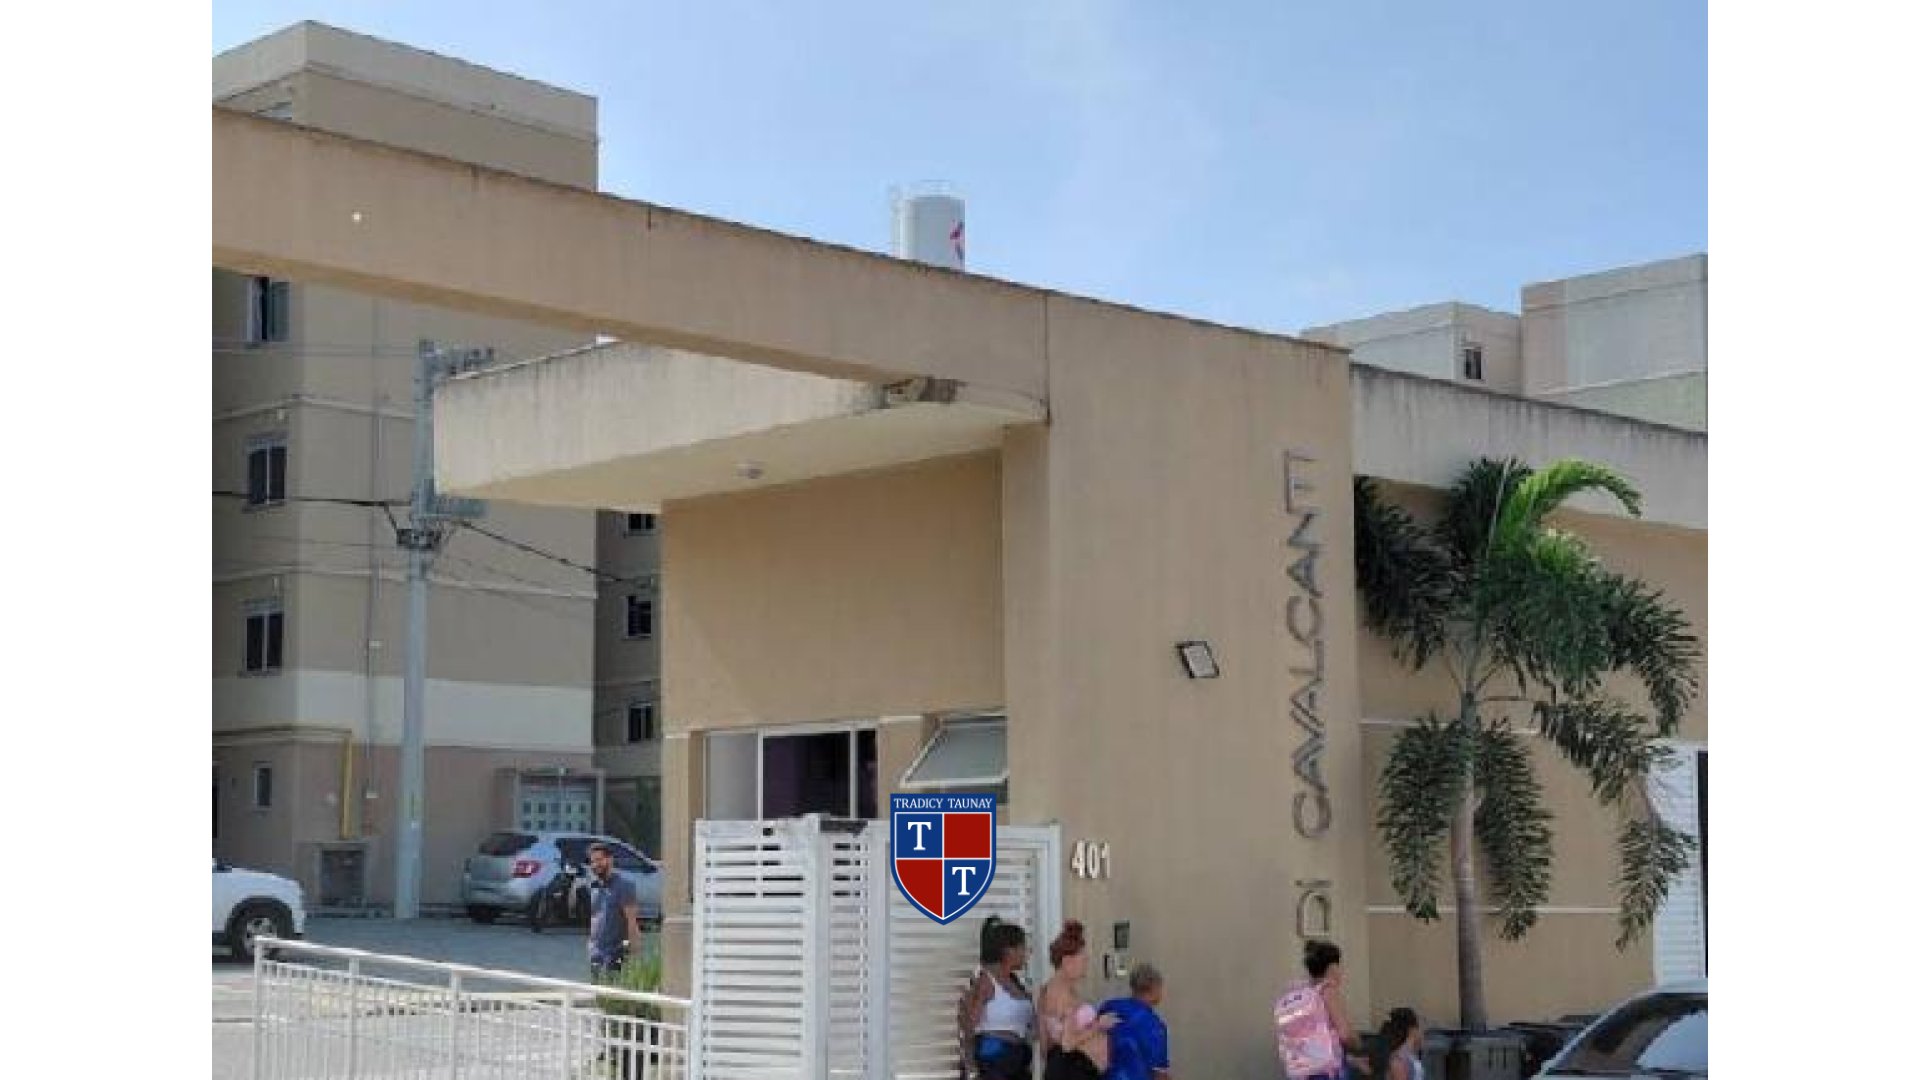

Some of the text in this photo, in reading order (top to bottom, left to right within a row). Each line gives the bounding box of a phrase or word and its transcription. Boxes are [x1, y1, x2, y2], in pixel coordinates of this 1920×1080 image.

[1283, 449, 1333, 939] DI CAVALCANTI
[1070, 839, 1111, 880] 401
